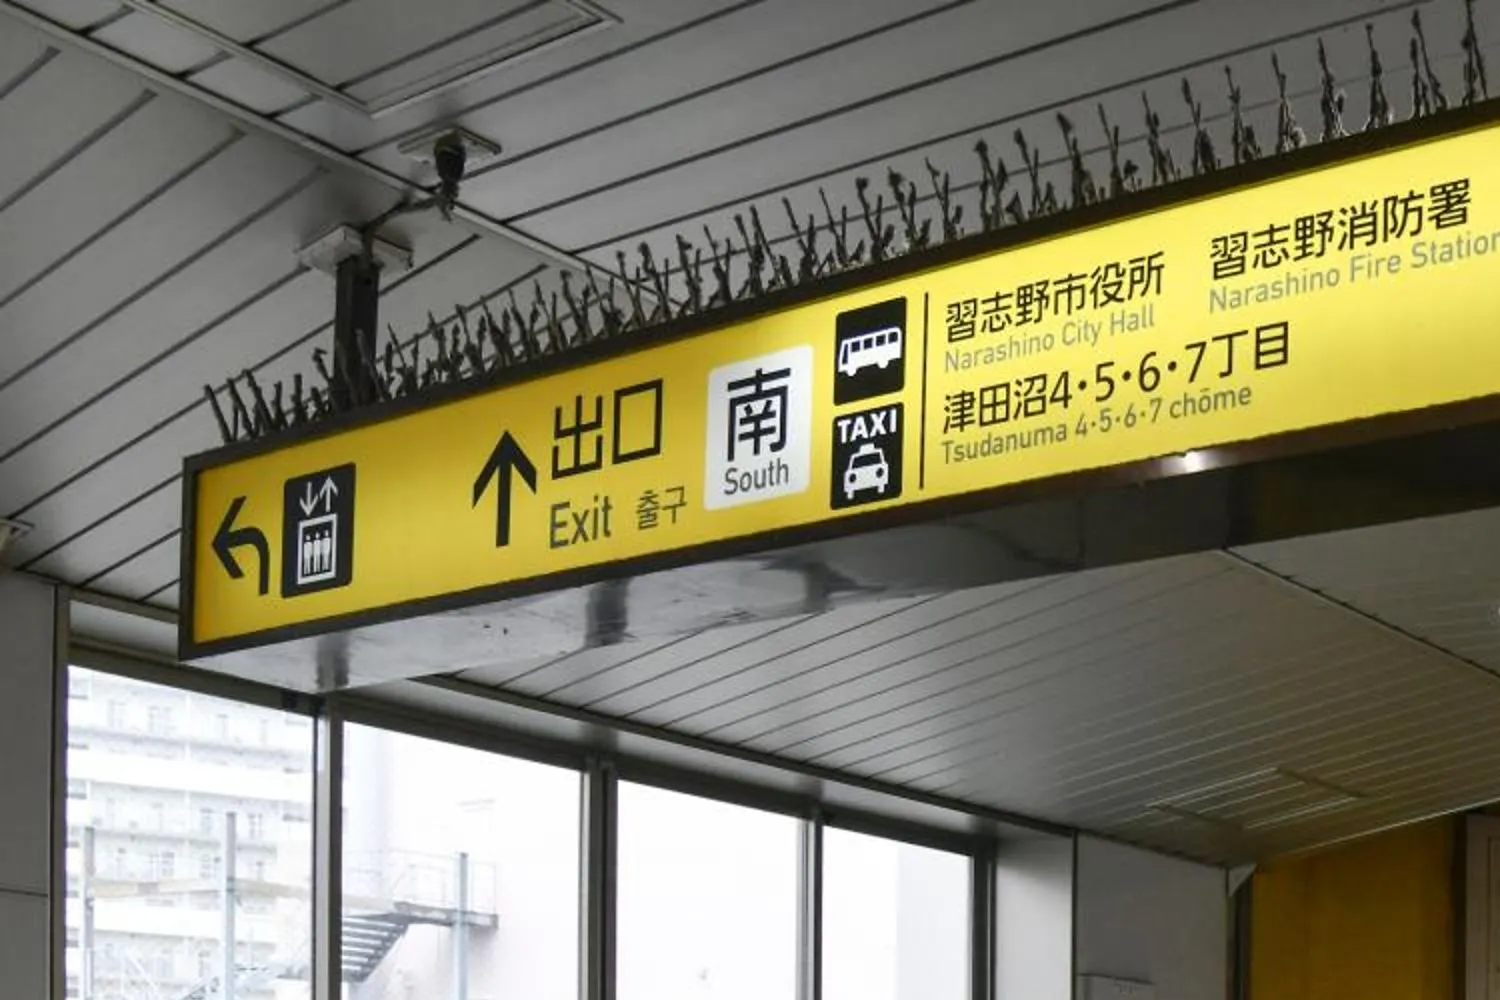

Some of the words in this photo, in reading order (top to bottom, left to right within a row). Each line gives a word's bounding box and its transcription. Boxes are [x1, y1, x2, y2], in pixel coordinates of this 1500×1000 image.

[945, 251, 1165, 343] 習志野市役所
[1210, 179, 1471, 280] 習志野消防署
[1209, 265, 1340, 313] Narashino
[1349, 250, 1401, 283] Fire
[945, 331, 1054, 373] Narashino
[1062, 317, 1103, 347] City
[1111, 305, 1155, 335] Hall
[552, 379, 663, 479] 出口
[726, 367, 792, 462] 南
[838, 407, 897, 444] TAXI
[942, 421, 1067, 464] Tsudanuma
[1170, 386, 1252, 420] chōme
[636, 485, 689, 530] 출구
[724, 457, 789, 496] South
[549, 495, 613, 549] Exit
